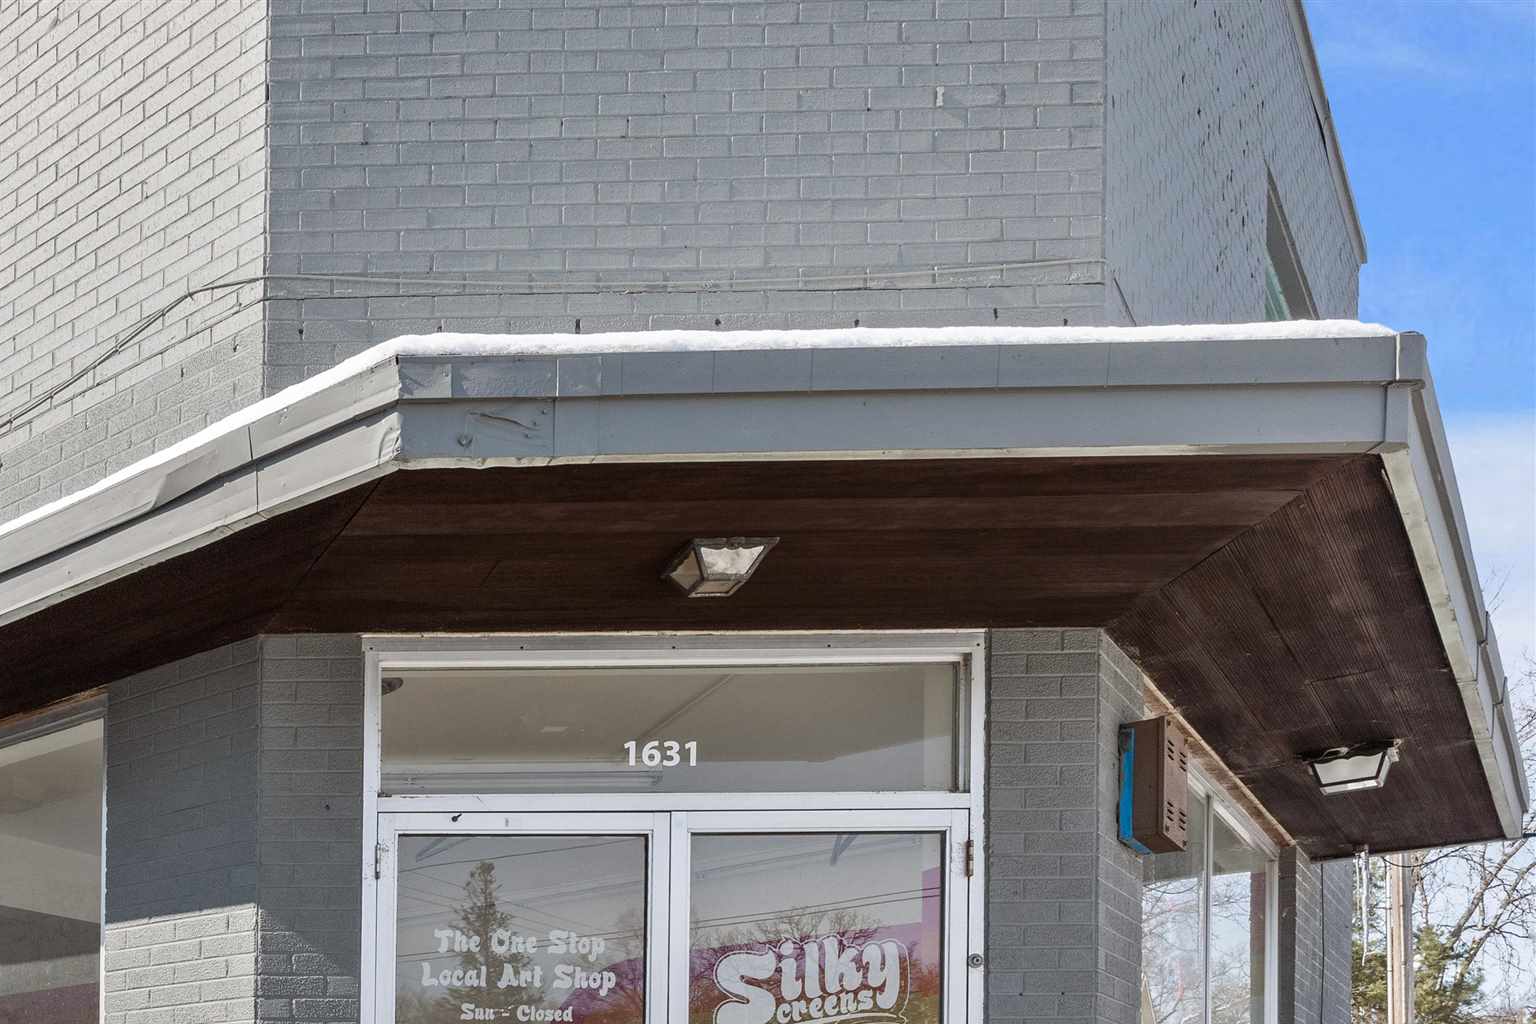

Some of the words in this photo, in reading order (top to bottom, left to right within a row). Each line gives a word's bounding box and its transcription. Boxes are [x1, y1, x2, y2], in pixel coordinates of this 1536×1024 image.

[624, 740, 697, 767] 1631
[434, 928, 481, 953] The
[490, 928, 538, 954] One
[547, 930, 607, 961] Stop
[421, 961, 488, 988] Local
[496, 963, 543, 988] Art
[552, 964, 617, 996] Shop
[460, 1002, 496, 1021] Sun
[516, 1004, 574, 1022] Closed
